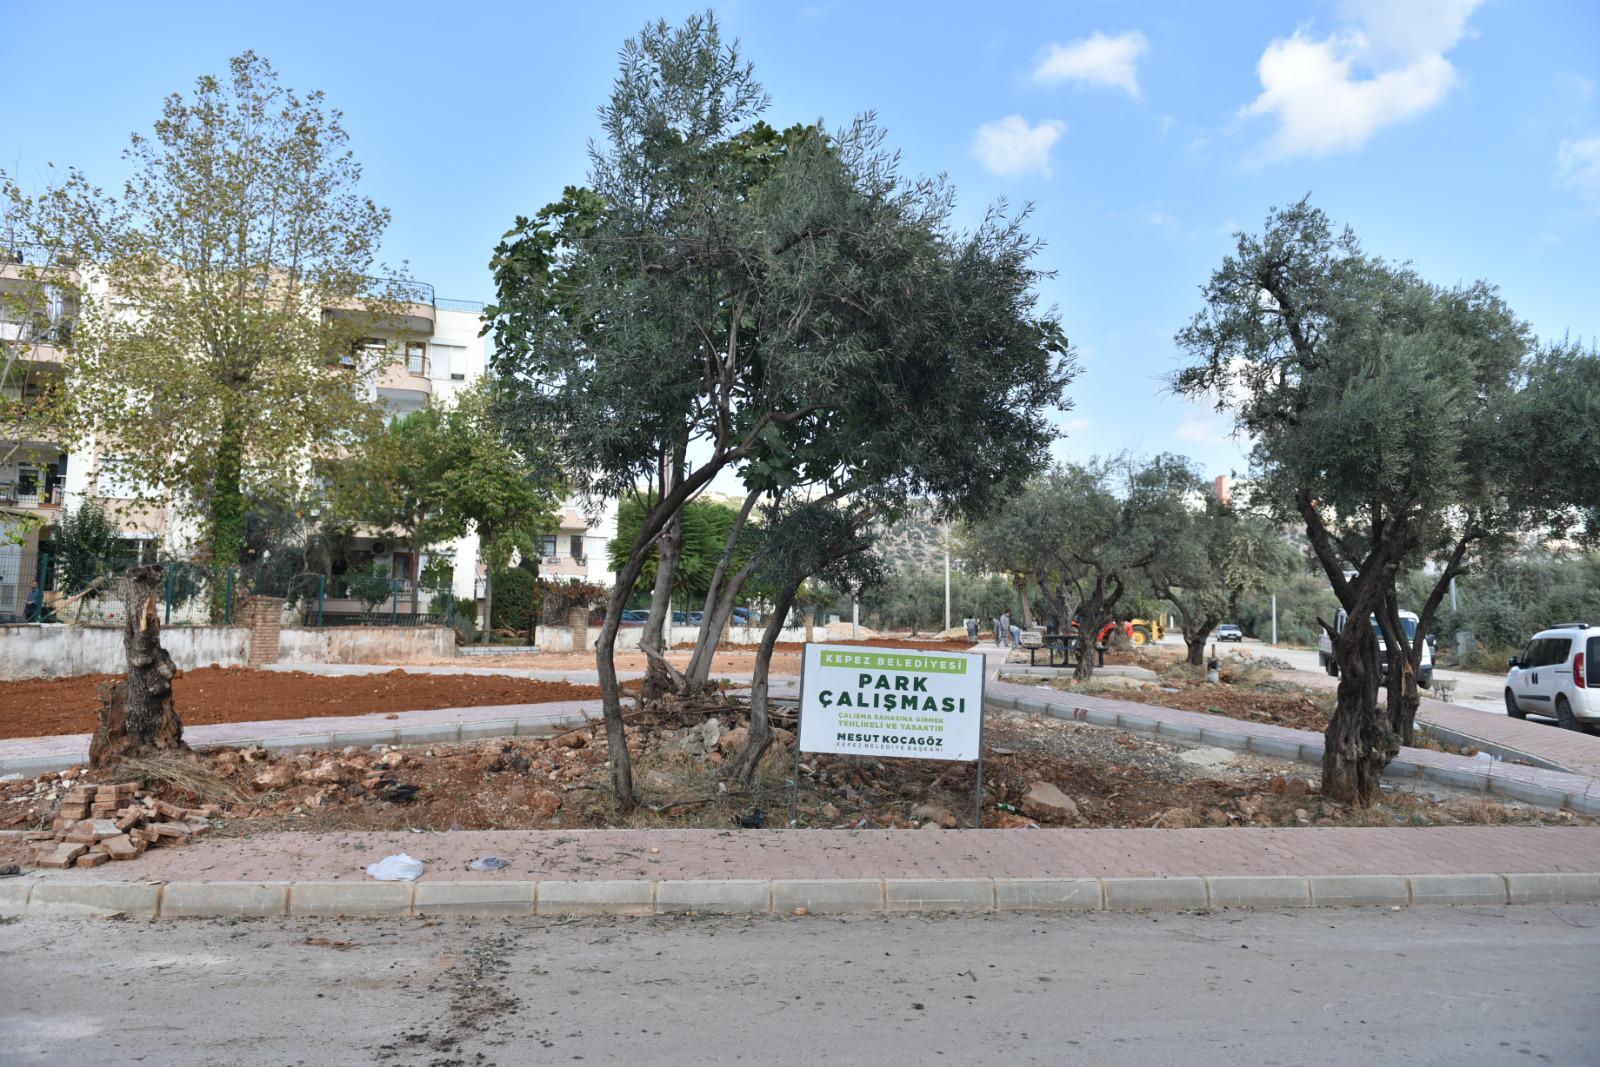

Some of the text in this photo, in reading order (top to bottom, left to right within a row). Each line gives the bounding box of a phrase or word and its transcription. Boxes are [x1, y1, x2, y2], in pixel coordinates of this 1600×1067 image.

[825, 654, 962, 671] KEPEZ BELEDİYESİ
[858, 673, 928, 692] PARK
[818, 690, 965, 713] ÇALIŞMASI
[900, 723, 944, 732] YASAKTIR
[837, 733, 943, 746] MESUT KOCAGÖZ
